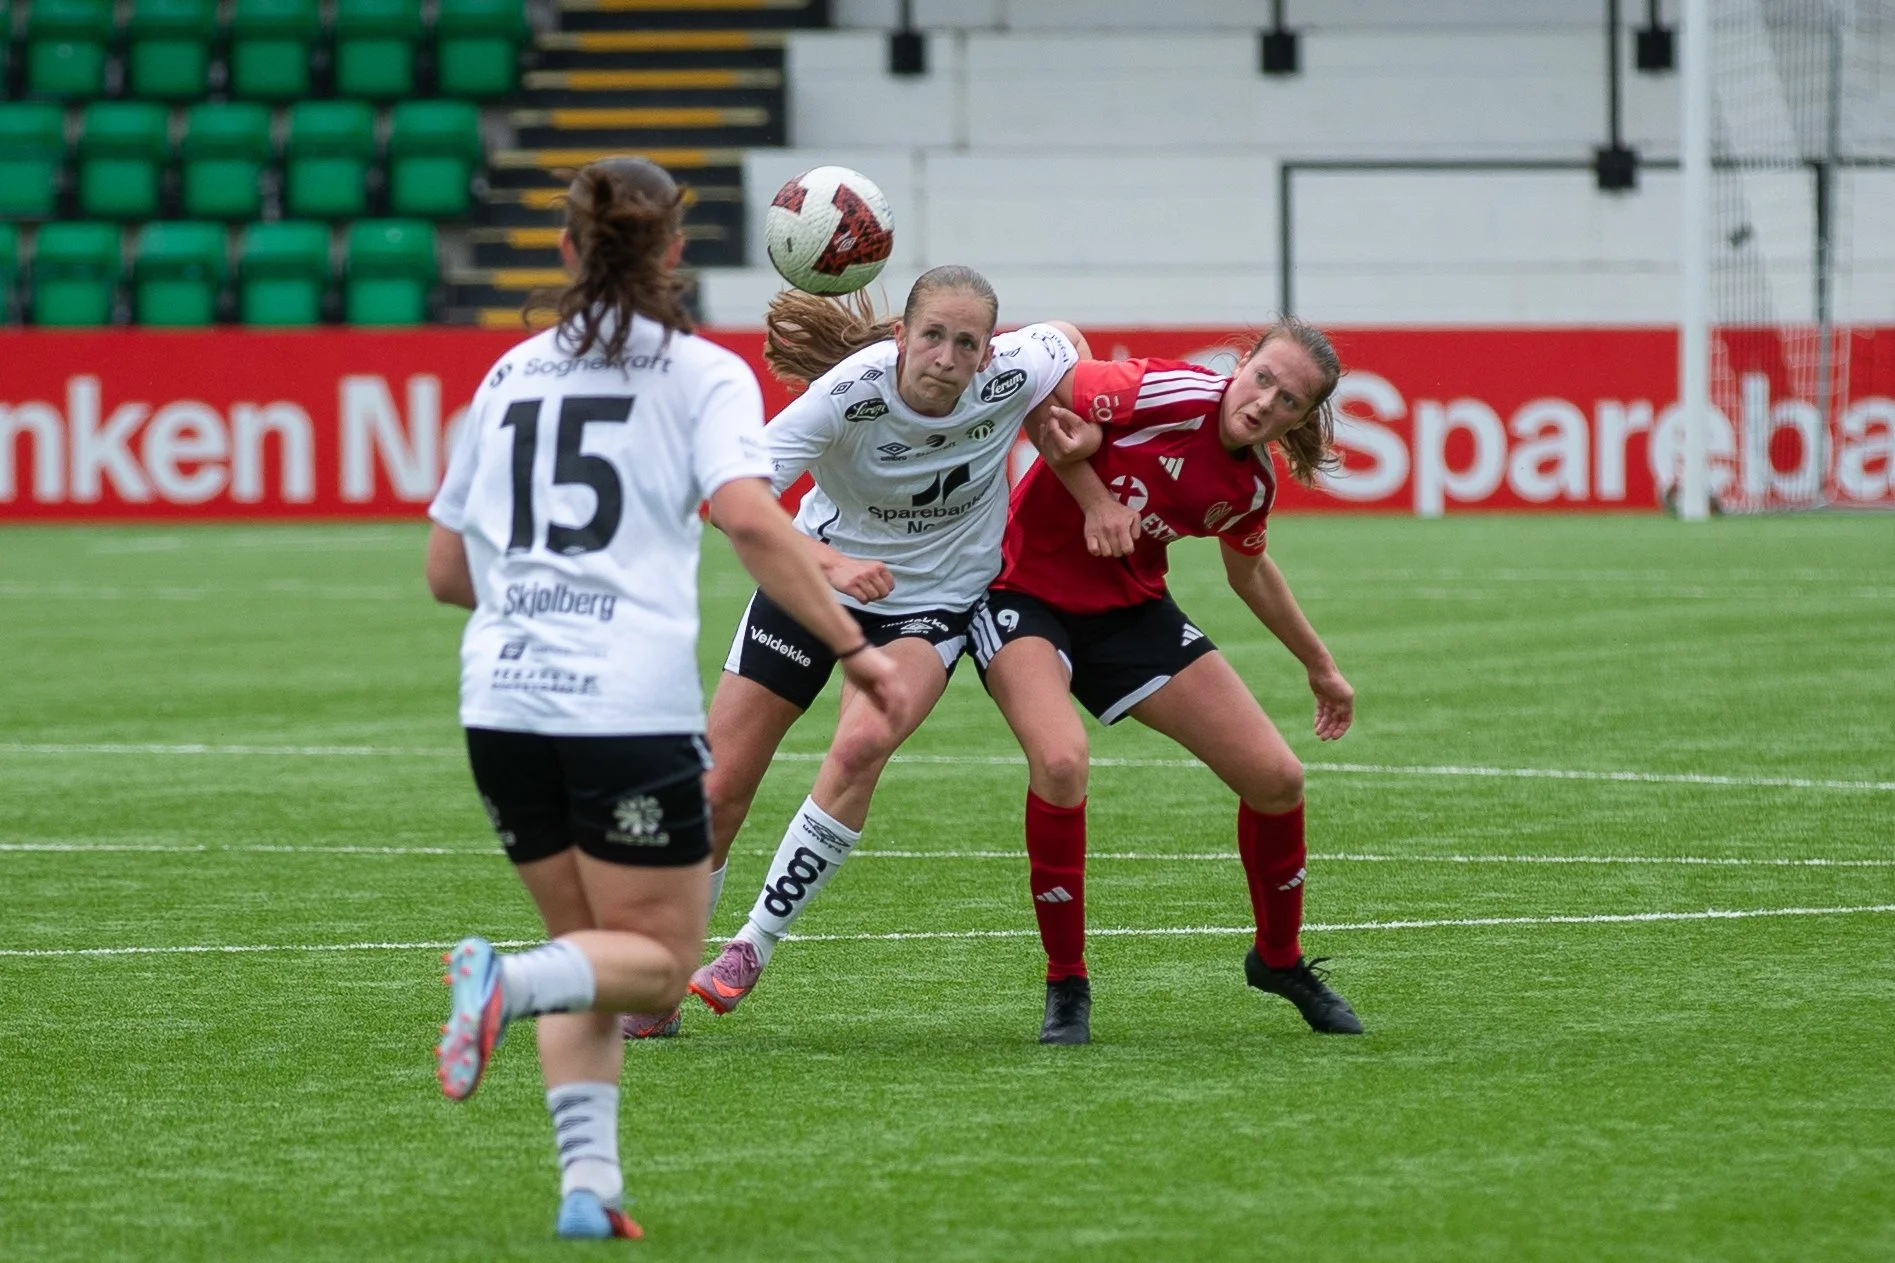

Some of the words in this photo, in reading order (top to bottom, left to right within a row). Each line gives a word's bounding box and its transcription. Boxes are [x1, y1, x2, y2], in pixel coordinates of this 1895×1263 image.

[984, 372, 1025, 402] Lerum
[337, 373, 471, 502] N
[500, 395, 636, 556] 15
[503, 579, 617, 622] Skjølberg
[997, 608, 1019, 632] 9
